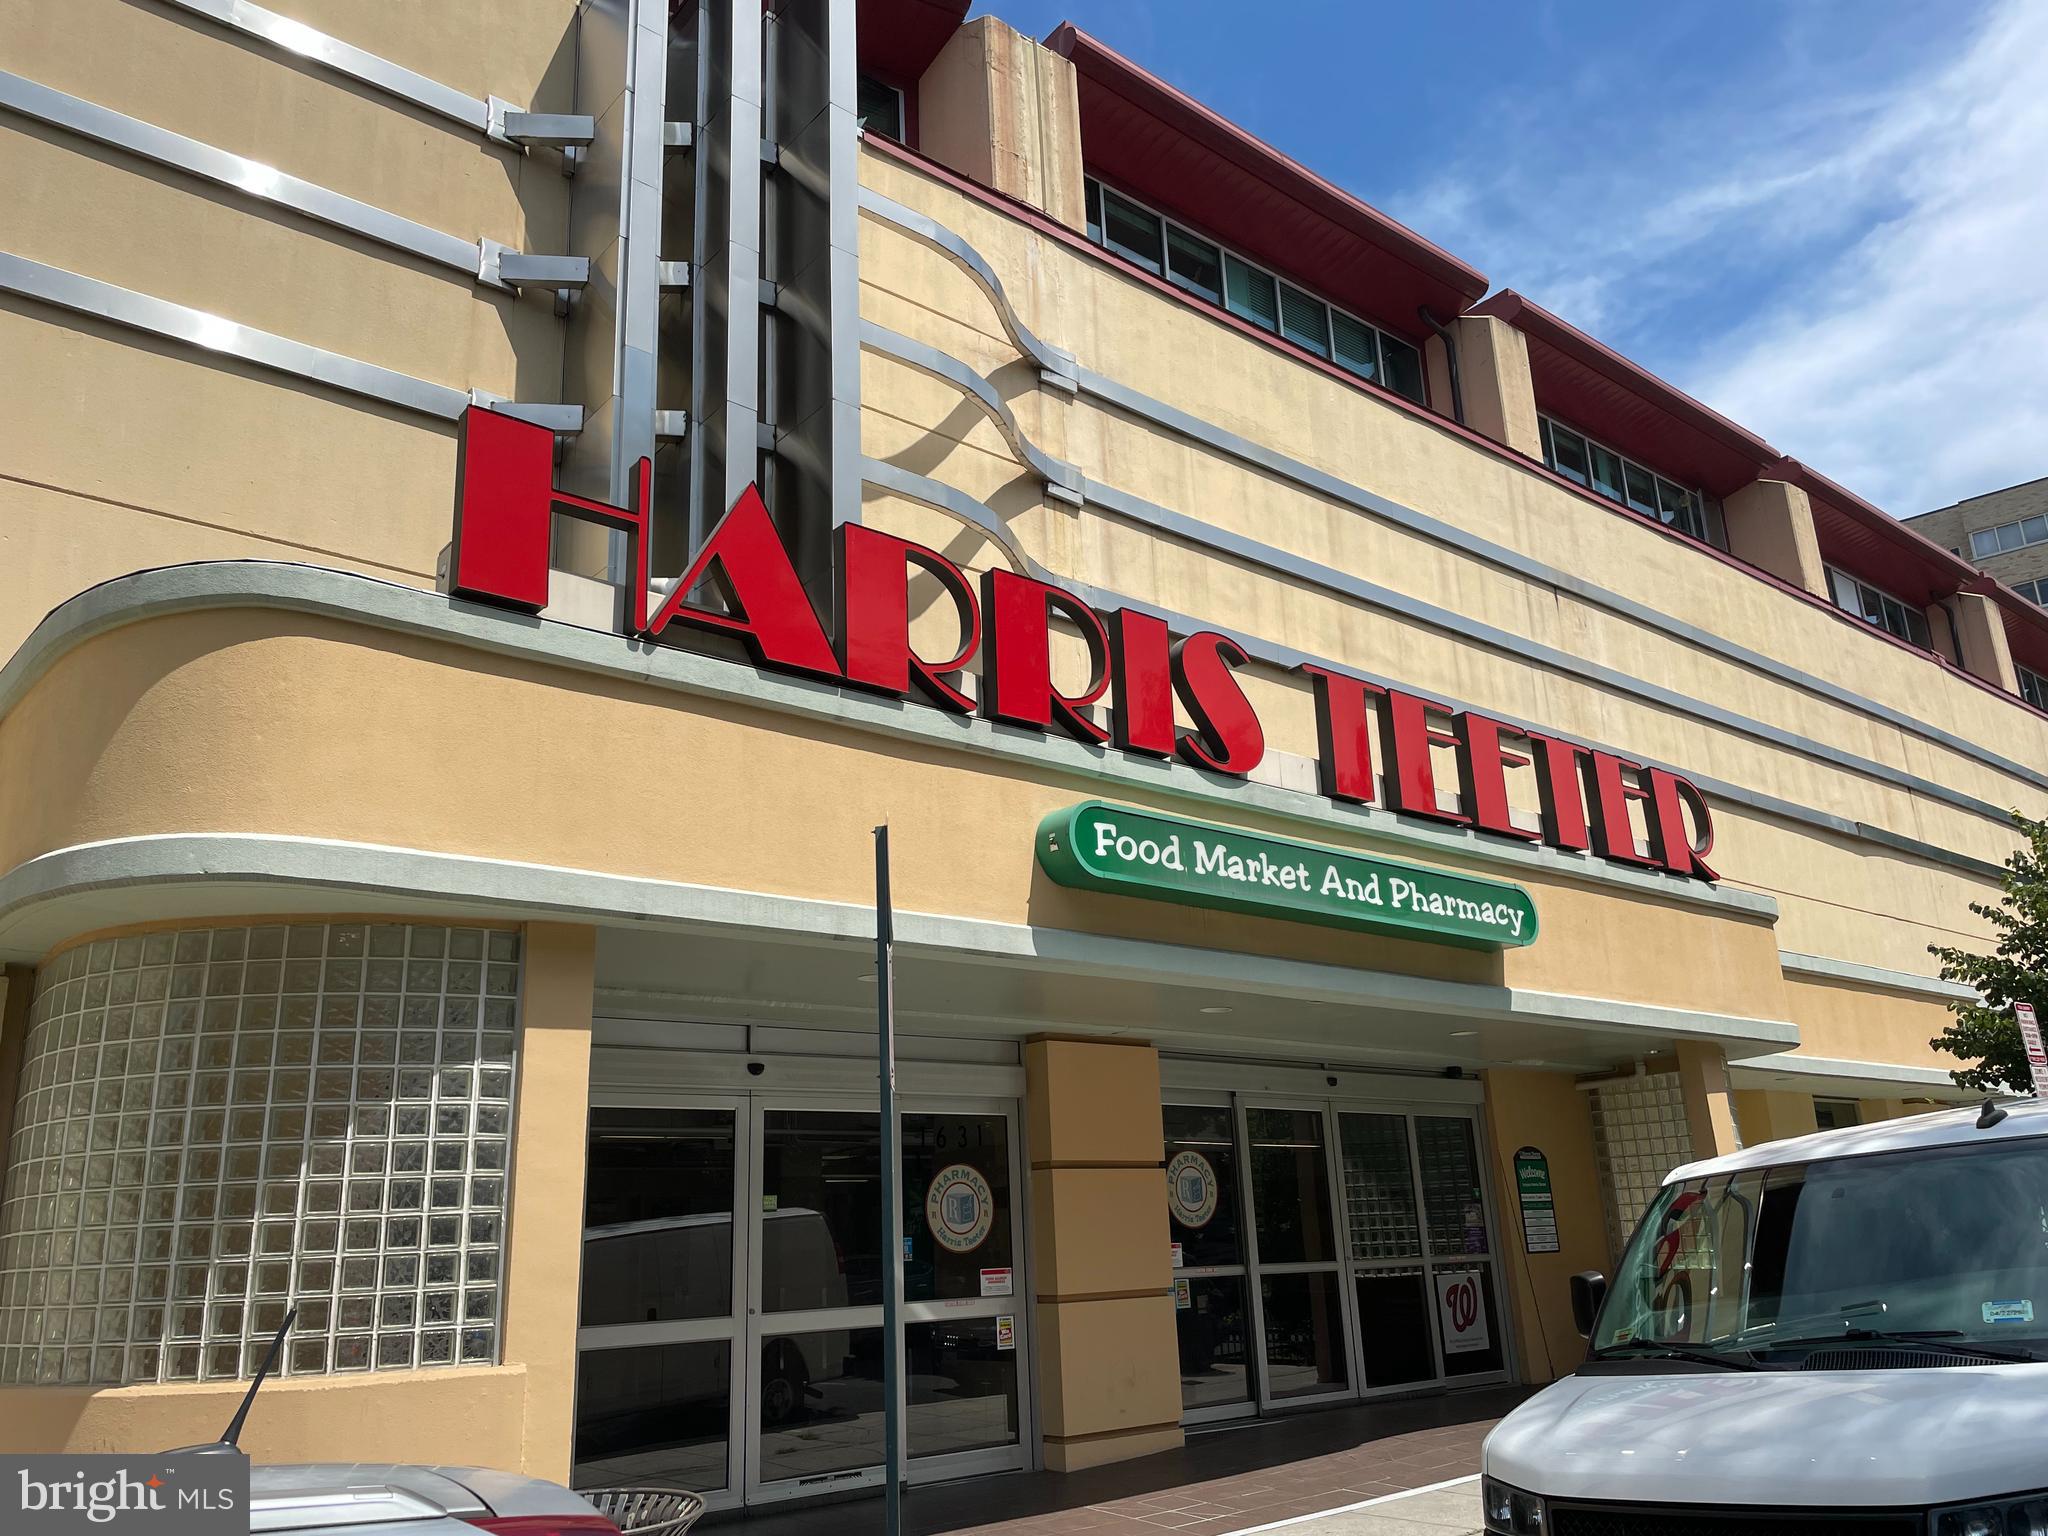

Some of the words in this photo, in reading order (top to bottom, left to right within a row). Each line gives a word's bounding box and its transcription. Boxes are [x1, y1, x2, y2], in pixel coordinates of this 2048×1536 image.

[450, 405, 1265, 776] HARRIS
[1302, 663, 1721, 881] TEETER
[1094, 822, 1184, 872] Food
[1194, 840, 1311, 891] Market
[1320, 866, 1383, 906] And
[1390, 877, 1525, 936] Pharmacy
[920, 1125, 983, 1149] 1631
[931, 1169, 990, 1206] PHARMACY
[1168, 1155, 1214, 1187] PHARMACY
[1519, 1165, 1546, 1180] Welcome
[937, 1226, 962, 1247] Harris
[964, 1225, 988, 1247] Teeter
[1446, 1276, 1478, 1333] W
